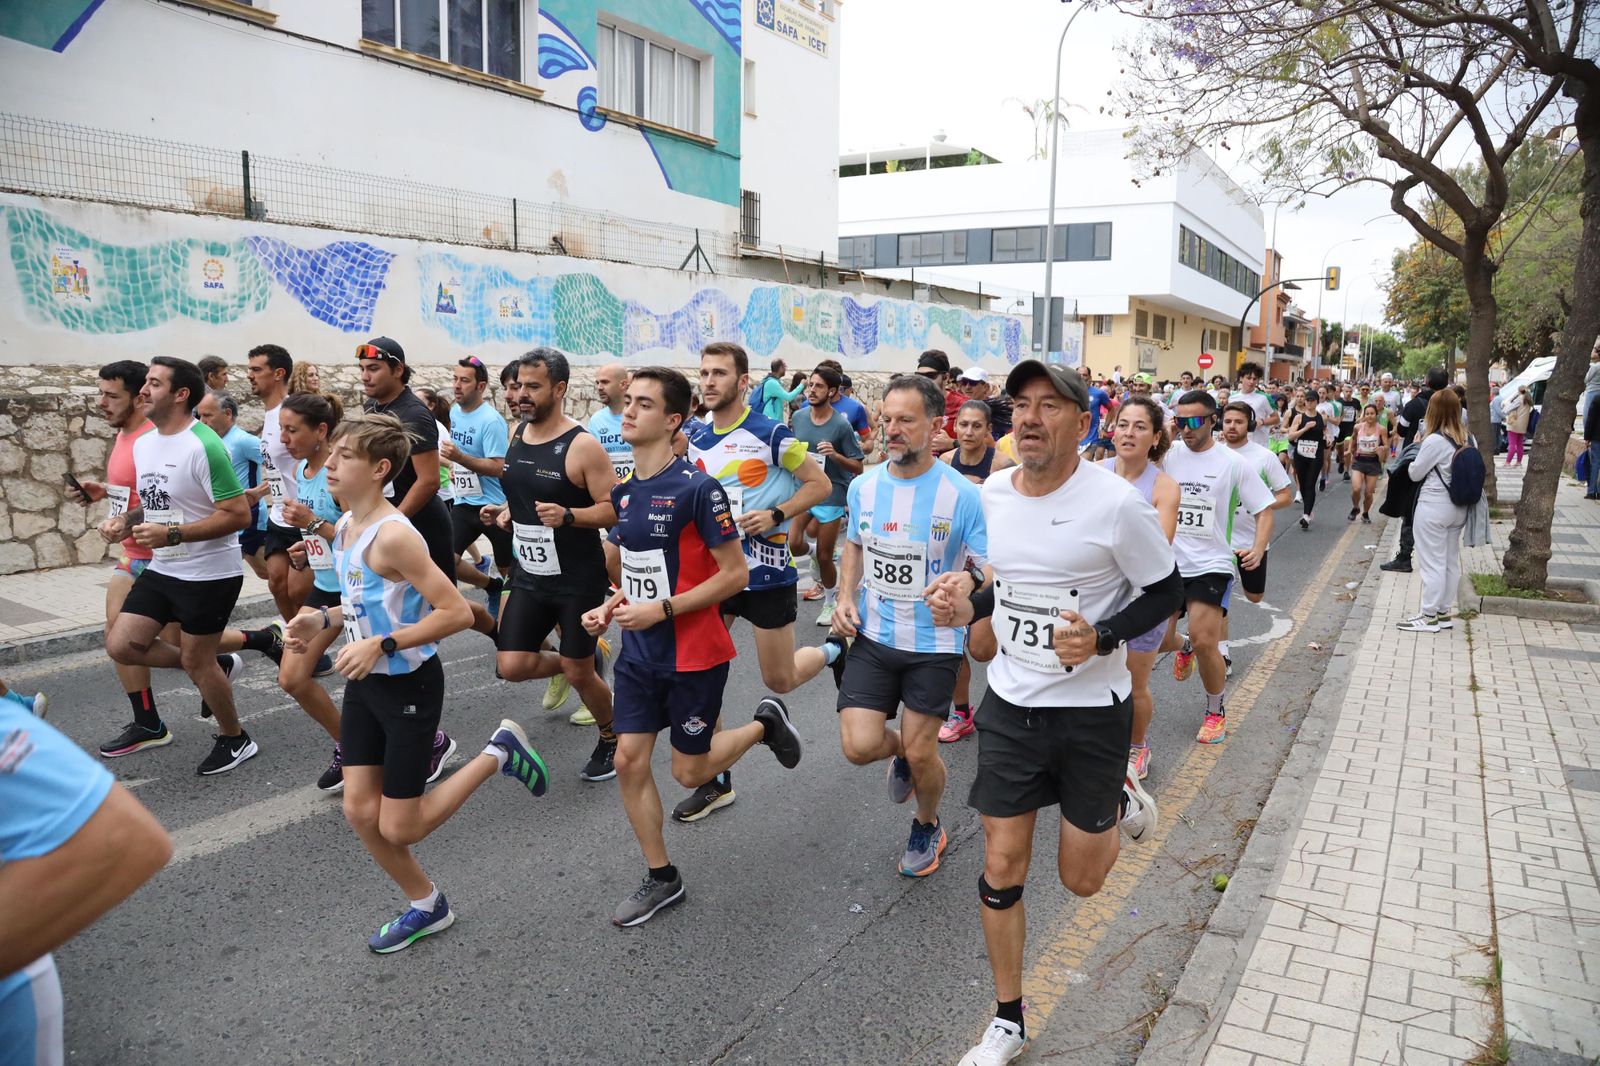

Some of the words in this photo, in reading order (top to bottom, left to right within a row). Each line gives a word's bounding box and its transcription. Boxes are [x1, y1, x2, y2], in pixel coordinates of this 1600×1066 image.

[776, 20, 799, 41] SAFA
[808, 35, 827, 54] ICET
[203, 281, 225, 290] SAFA
[270, 484, 283, 497] 51
[648, 513, 666, 521] Mobil
[1177, 510, 1205, 528] 431
[519, 544, 548, 563] 413
[873, 559, 913, 585] 588
[625, 574, 658, 599] 779
[1008, 615, 1055, 651] 731
